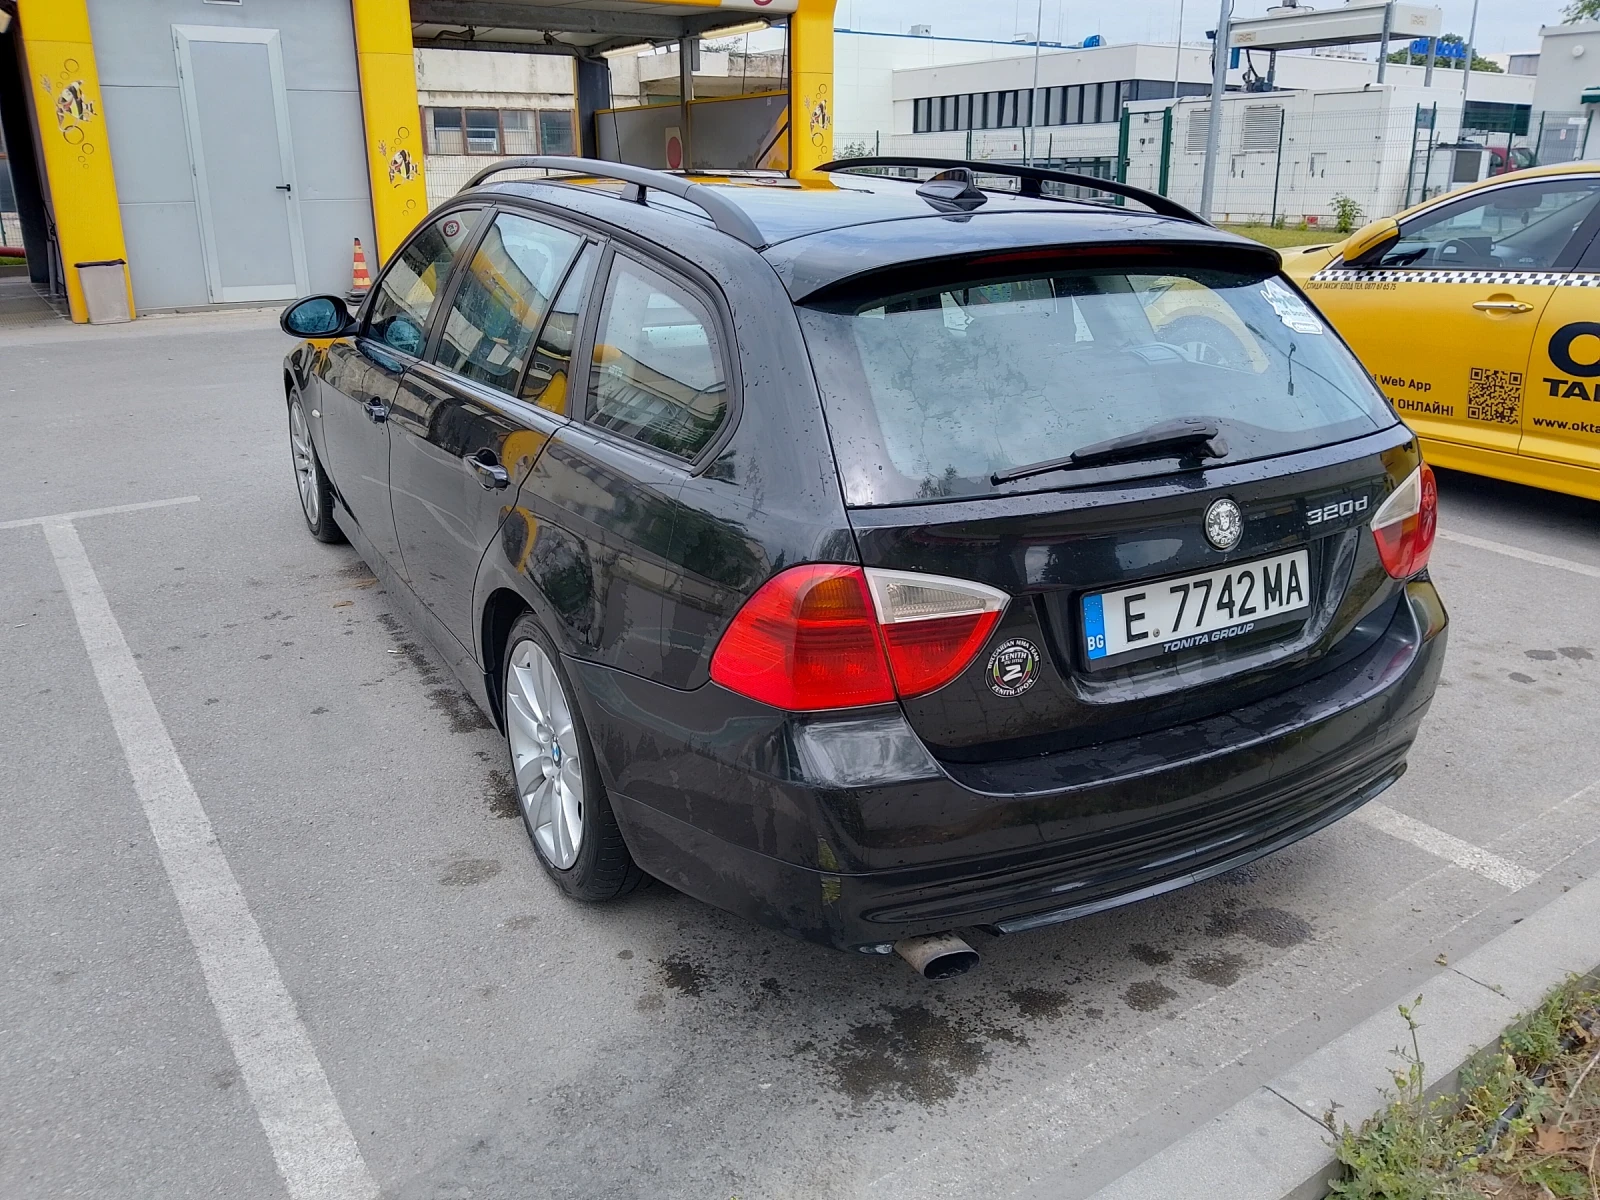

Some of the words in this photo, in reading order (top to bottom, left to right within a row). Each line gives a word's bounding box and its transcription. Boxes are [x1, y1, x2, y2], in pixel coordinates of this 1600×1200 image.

[1380, 375, 1405, 387] Web
[1408, 379, 1432, 392] App
[1398, 398, 1454, 416] ОНЛАЙН!
[1307, 496, 1368, 525] 320d
[1169, 570, 1257, 633] 7742
[1263, 559, 1304, 611] MA
[1087, 635, 1105, 651] BG
[1163, 632, 1209, 653] TONITA
[1211, 622, 1255, 641] GROUP
[1000, 652, 1027, 662] ZENITH
[1029, 646, 1039, 662] TEAM
[992, 678, 1033, 695] ZENITH-IPON
